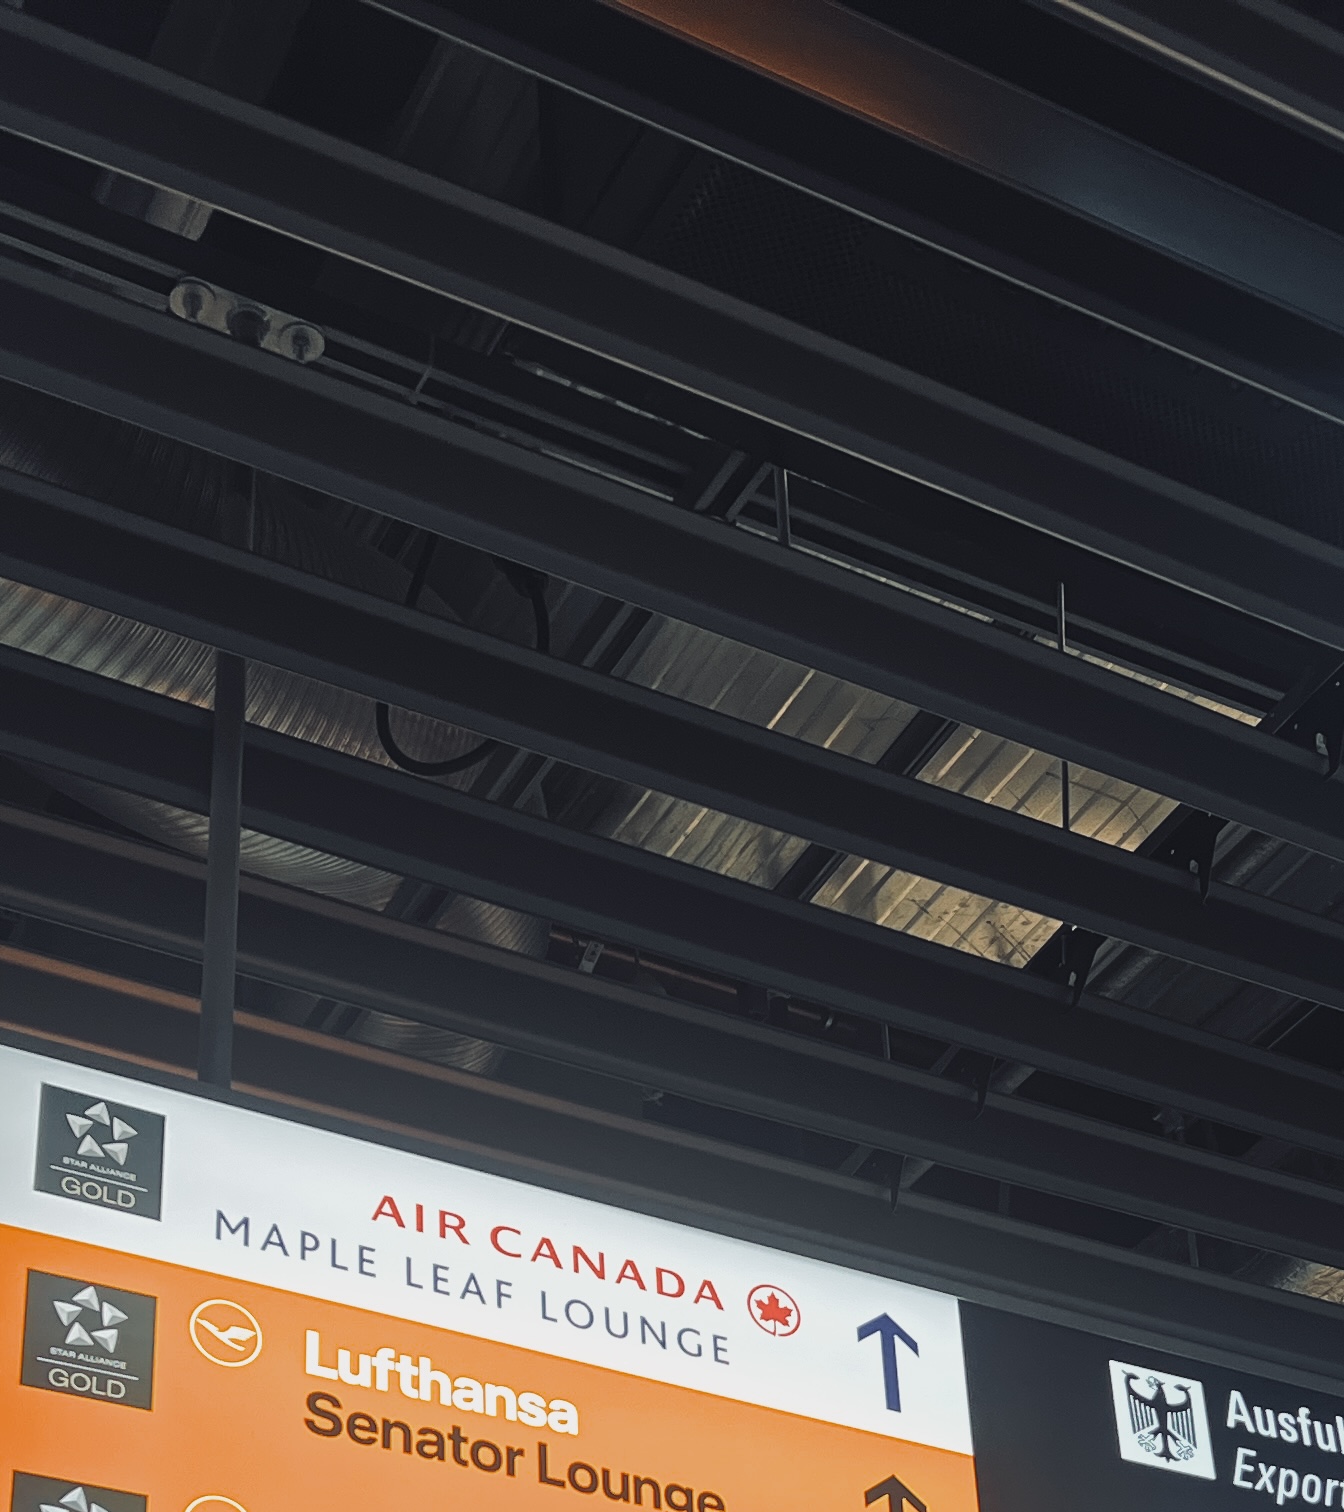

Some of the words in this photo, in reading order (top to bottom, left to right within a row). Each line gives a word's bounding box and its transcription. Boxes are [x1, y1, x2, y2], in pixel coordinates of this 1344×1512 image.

[61, 1176, 136, 1208] GOLD
[62, 1156, 88, 1168] STAR
[89, 1163, 137, 1181] ALLIANCE
[371, 1195, 470, 1246] AIR
[489, 1225, 725, 1311] CANADA
[214, 1209, 378, 1278] MAPLE
[406, 1256, 515, 1310] LEAF
[541, 1291, 731, 1366] LOUNGE
[47, 1367, 127, 1400] GOLD
[49, 1346, 77, 1359] STAR
[78, 1353, 127, 1371] ALLIANCE
[305, 1330, 580, 1436] Lufthansa
[304, 1390, 524, 1478] Senator
